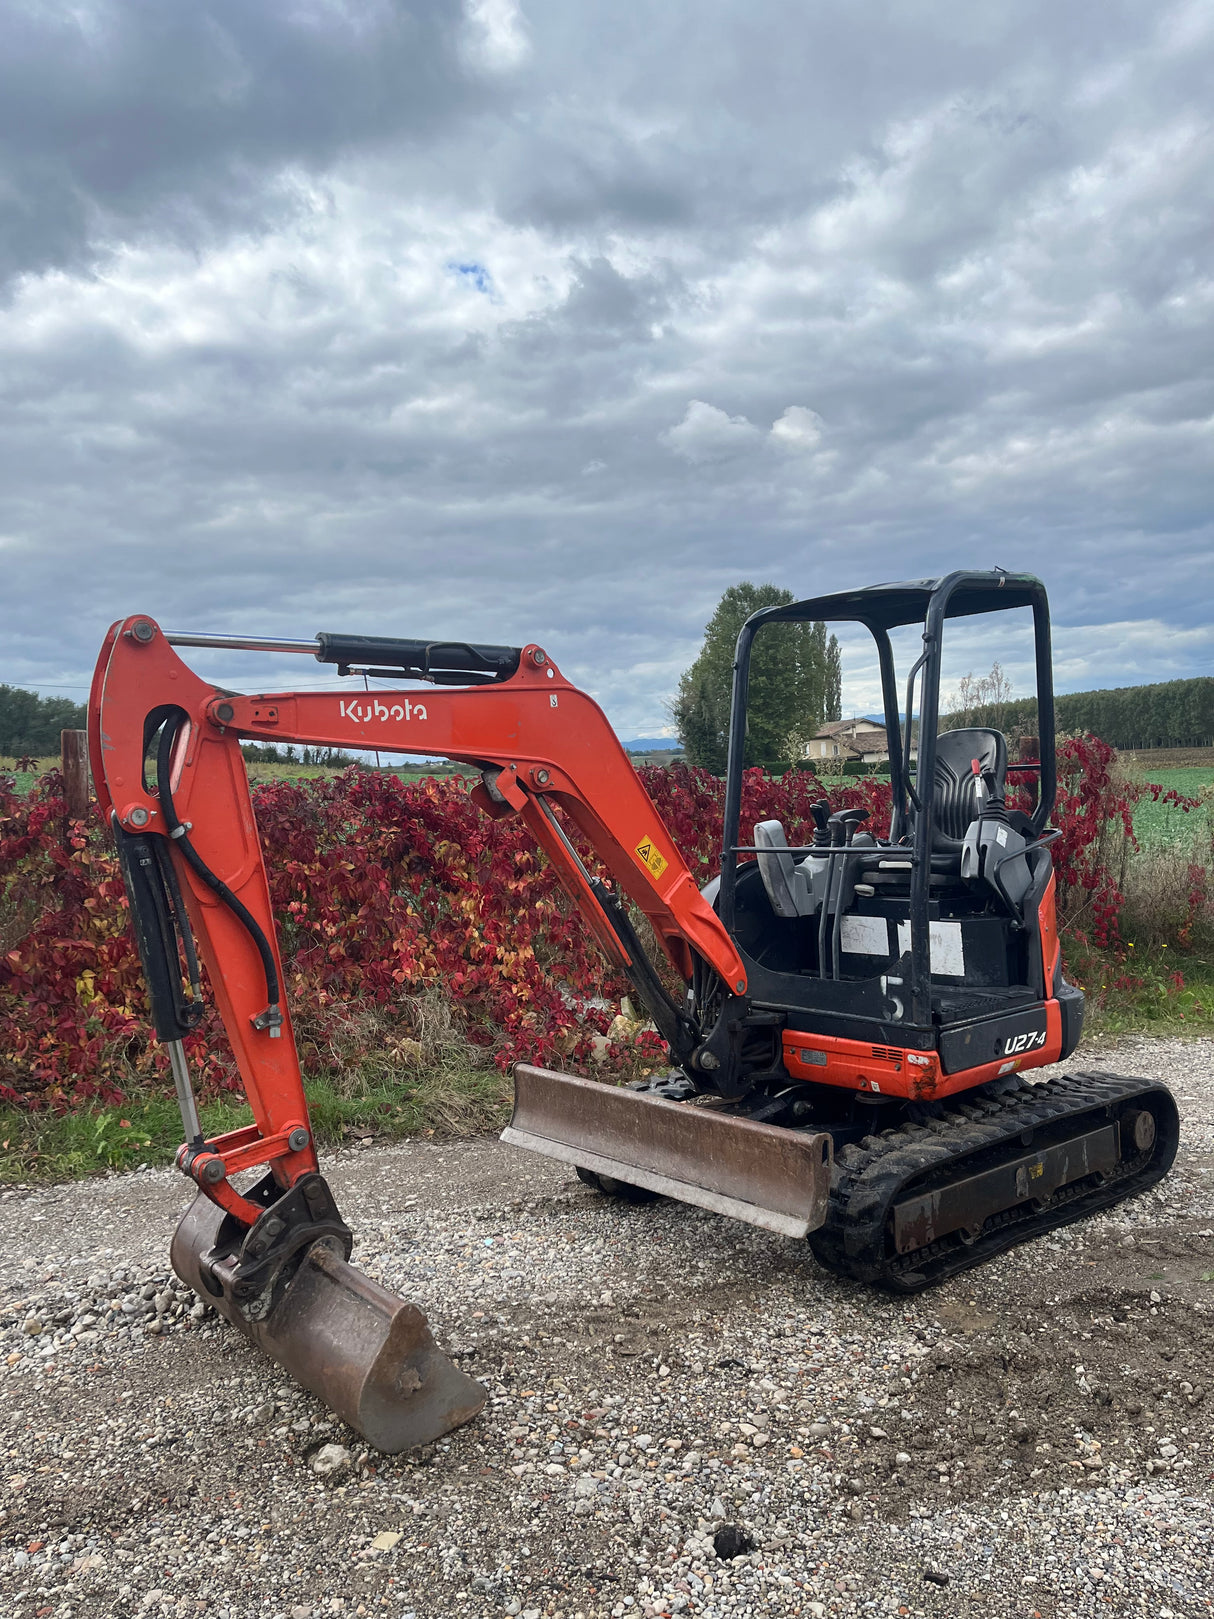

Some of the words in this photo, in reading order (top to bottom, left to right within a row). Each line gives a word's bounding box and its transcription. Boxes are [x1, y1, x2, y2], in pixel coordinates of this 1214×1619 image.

[340, 699, 427, 722] Kubota
[880, 975, 904, 1021] 5
[1004, 1031, 1046, 1055] U27-4
